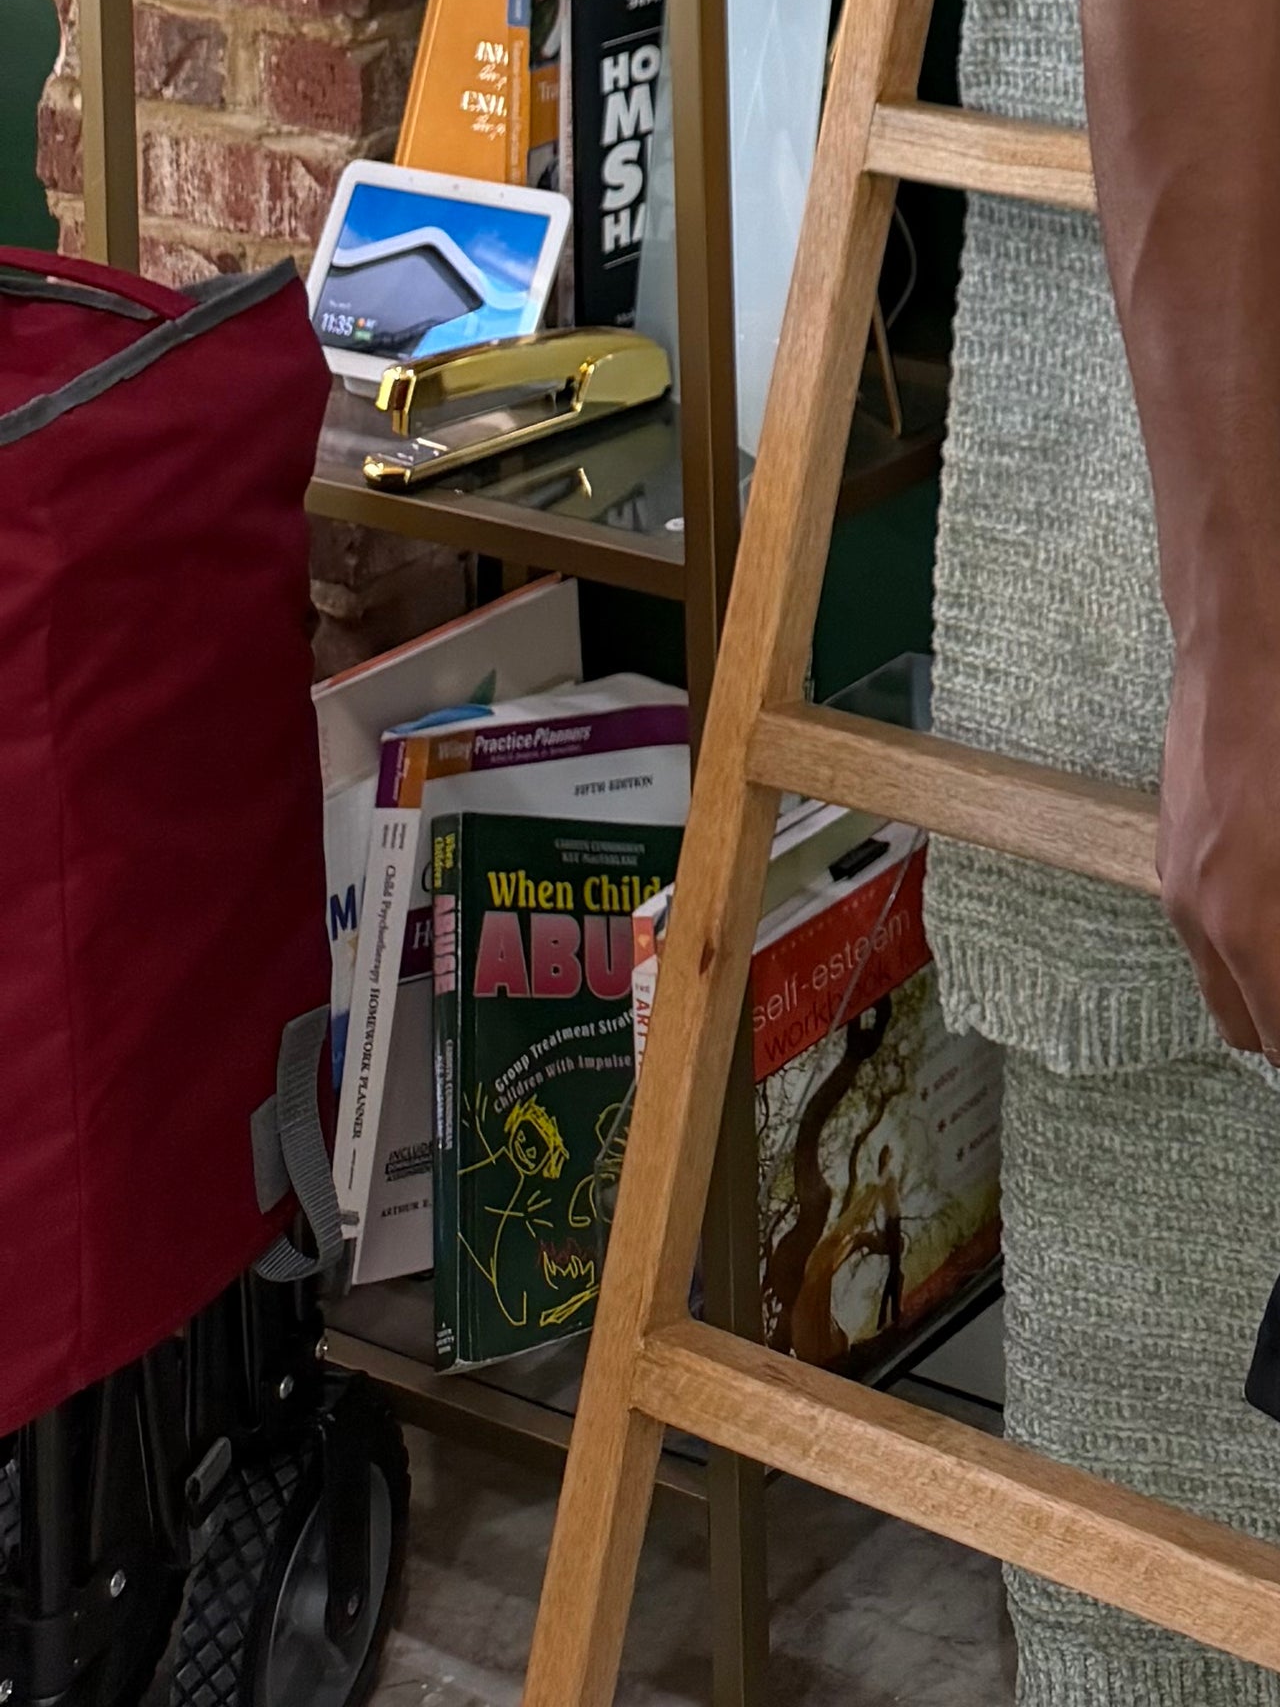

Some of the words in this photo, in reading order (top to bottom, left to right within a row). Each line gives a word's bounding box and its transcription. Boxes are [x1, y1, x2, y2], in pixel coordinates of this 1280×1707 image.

[321, 312, 355, 337] 11:35
[608, 774, 653, 792] EDITION
[381, 864, 398, 897] Child
[486, 870, 574, 911] When
[369, 899, 393, 985] Psychotherapy
[434, 894, 456, 997] ABUSE
[752, 909, 911, 1033] self-esteem
[362, 987, 381, 1073] HOMEWORK
[494, 1053, 531, 1093] Group
[528, 1022, 597, 1060] Treatment
[352, 1075, 370, 1139] PLANNER
[493, 1069, 545, 1114] Children
[577, 1053, 633, 1072] Impulse
